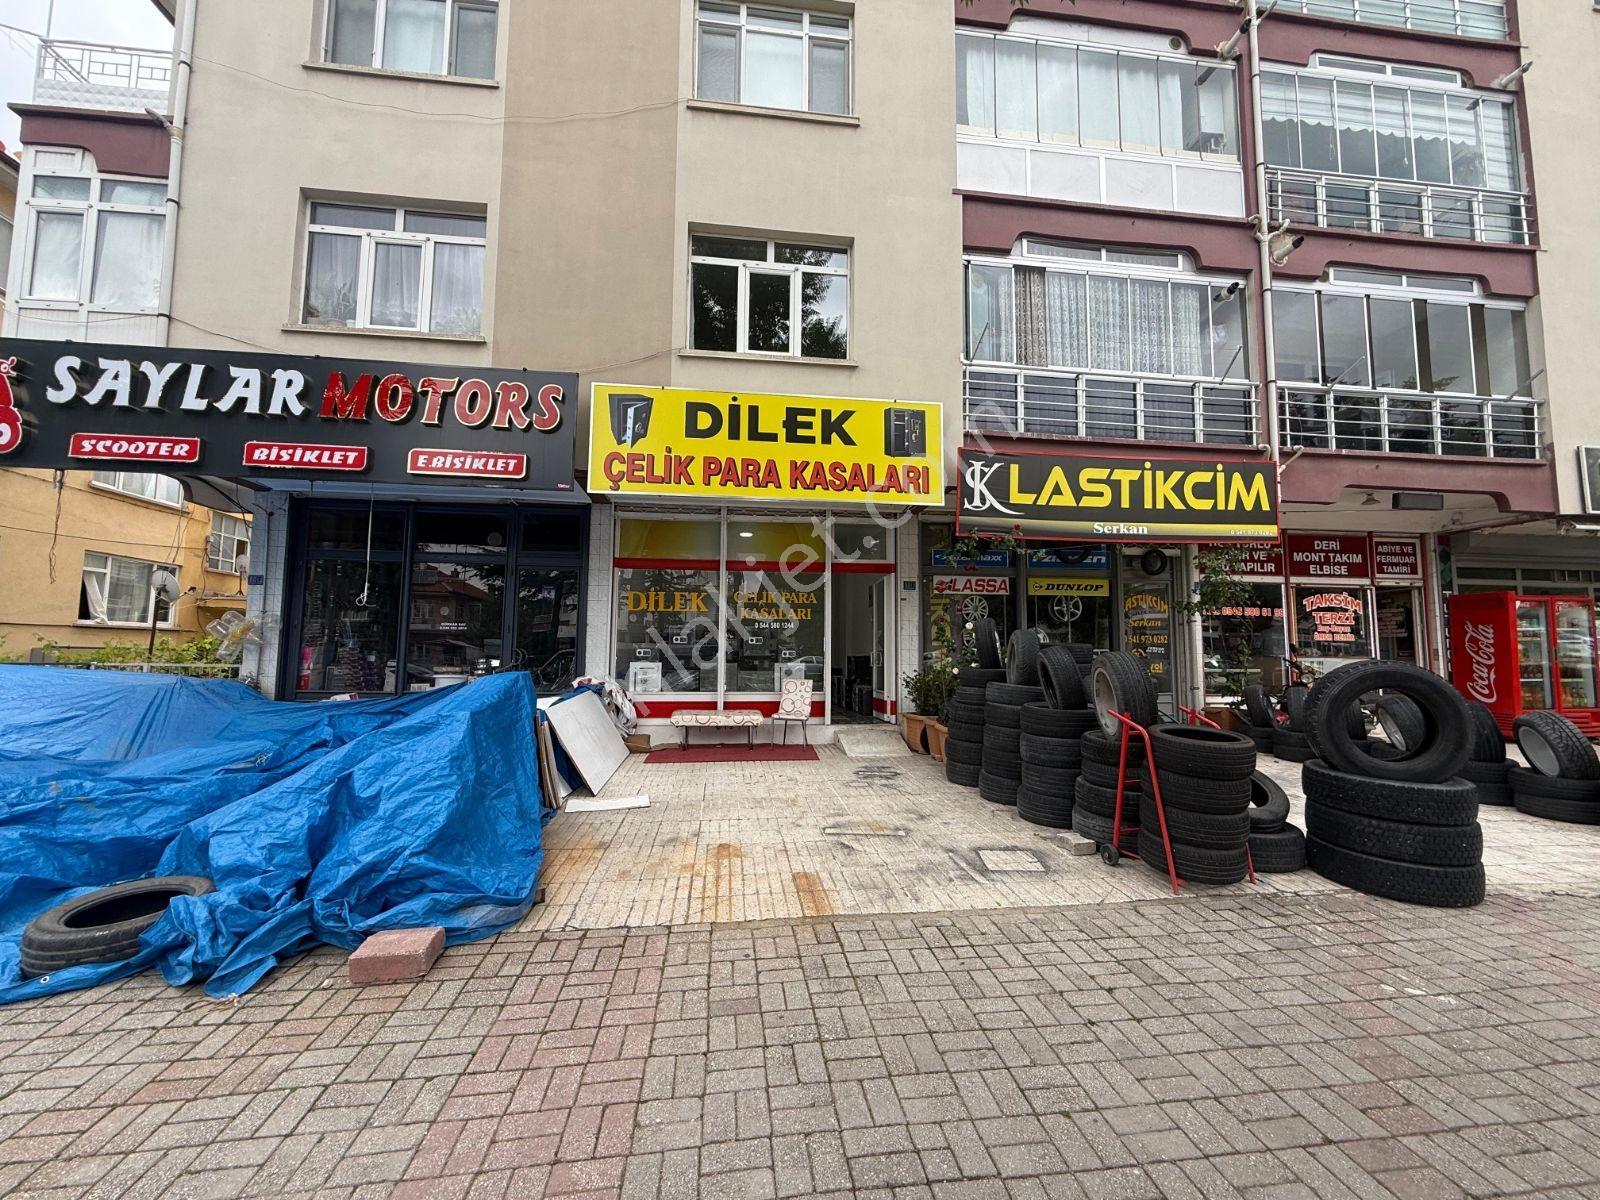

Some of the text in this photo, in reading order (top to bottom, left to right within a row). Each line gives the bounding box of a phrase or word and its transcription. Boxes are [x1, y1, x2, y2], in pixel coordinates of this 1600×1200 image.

[46, 355, 564, 432] SAYLAR MOTORS
[684, 395, 857, 447] DİLEK
[80, 438, 191, 457] SCOOTER
[252, 446, 359, 465] BİSİKLET
[603, 445, 930, 494] ÇELİK PARA KASALARI
[1008, 460, 1271, 512] LASTİKCİM
[1092, 522, 1148, 536] Serkan
[1314, 538, 1340, 551] DERİ
[1377, 543, 1414, 554] ABİYE VE
[1293, 552, 1363, 564] MONT TAKIM
[1376, 555, 1416, 564] FERMUAR
[1309, 562, 1349, 576] ELBİSE
[1382, 563, 1411, 574] TAMİRİ
[952, 578, 1009, 593] LASSA
[1044, 583, 1104, 592] DUNLOP
[627, 587, 709, 613] DİLEK
[781, 590, 818, 605] PARA
[1303, 591, 1364, 615] TAKSİM
[740, 602, 813, 621] KASALARI
[1312, 608, 1356, 626] TERZİ
[1128, 617, 1161, 627] Serkan
[1464, 617, 1498, 704] Coca-Cola
